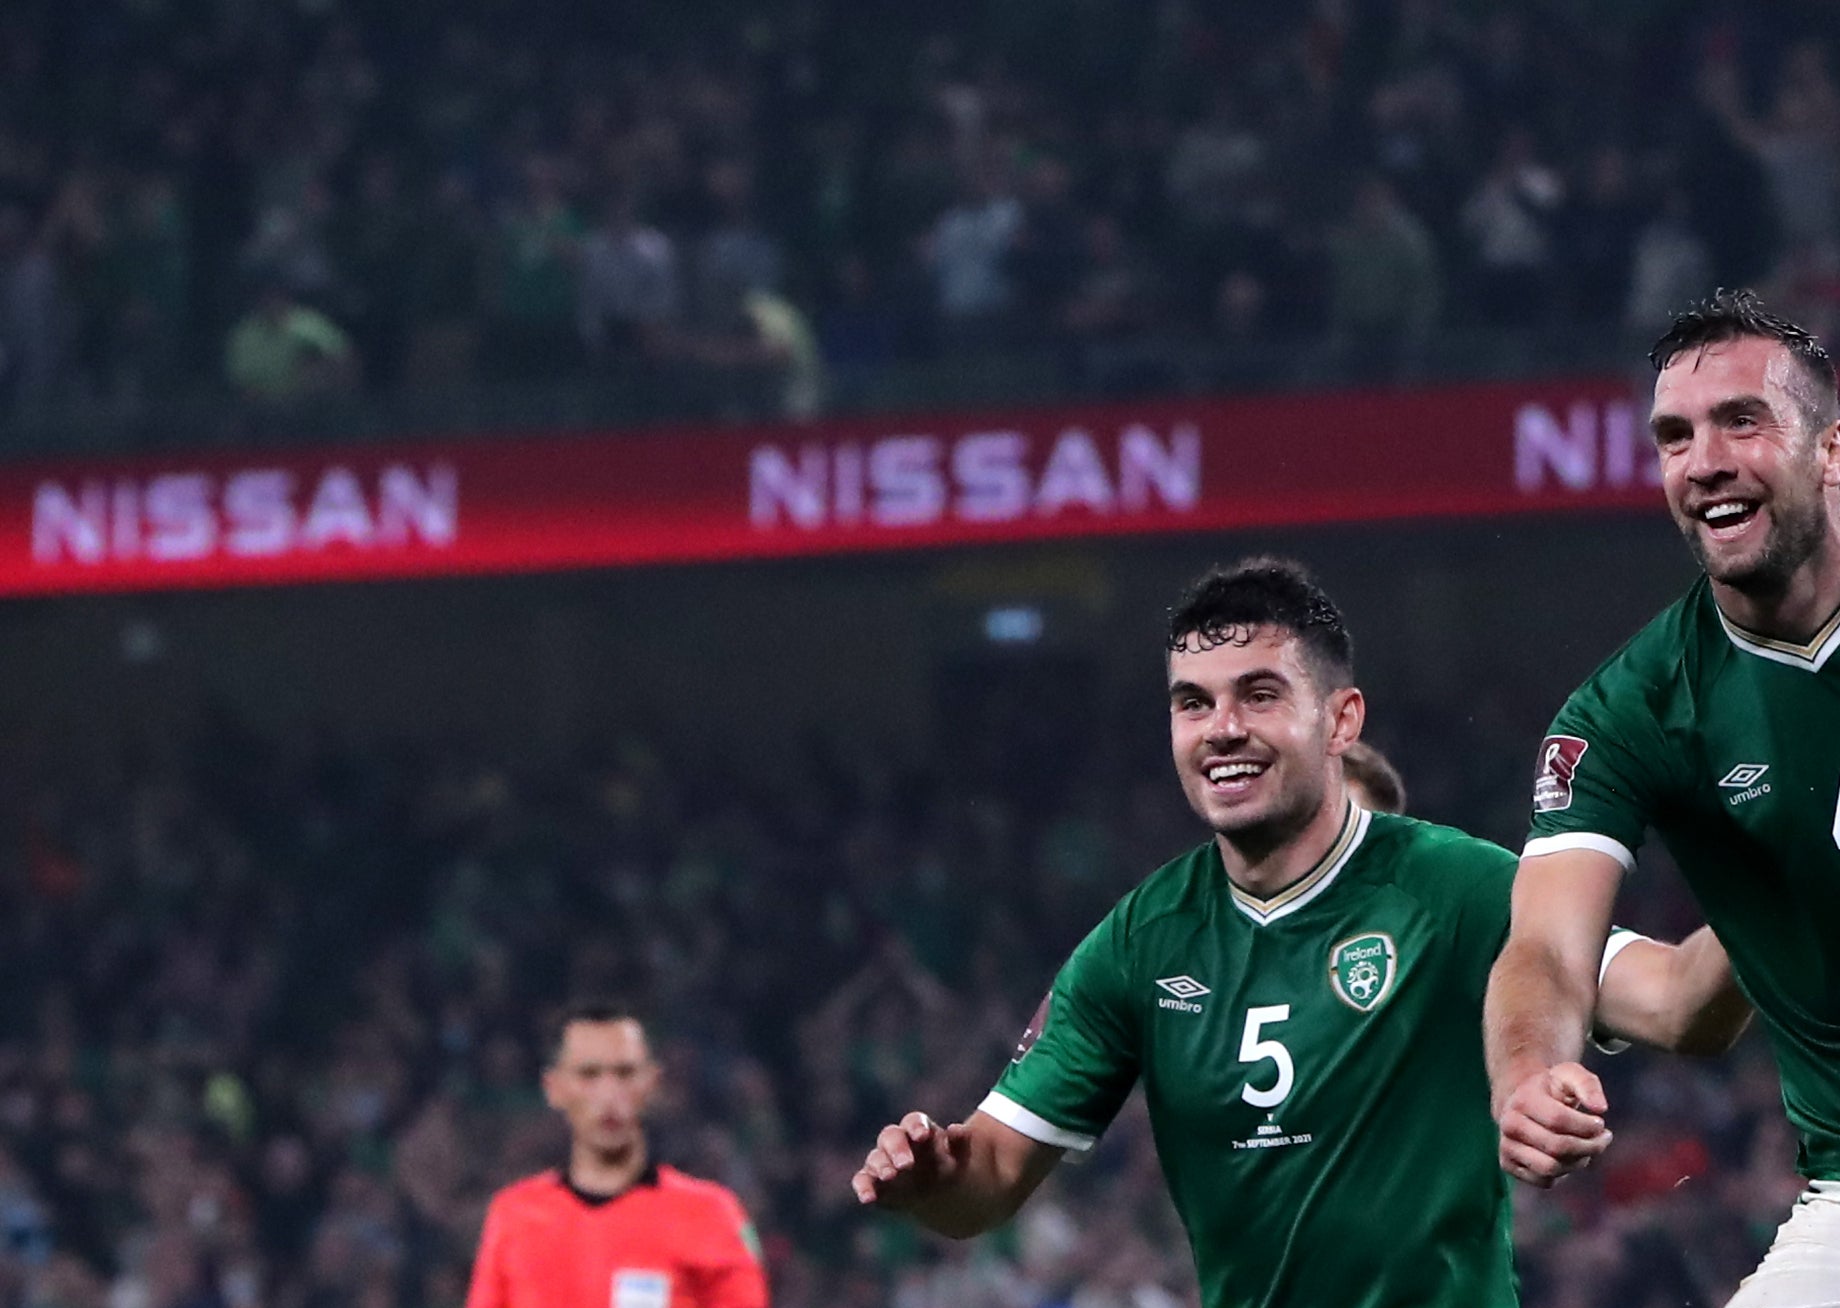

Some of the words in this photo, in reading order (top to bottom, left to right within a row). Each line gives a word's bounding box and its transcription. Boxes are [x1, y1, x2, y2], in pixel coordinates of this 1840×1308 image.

[747, 422, 1202, 532] NISSAN
[30, 463, 459, 566] NISSAN
[1729, 783, 1771, 806] umbro
[1343, 942, 1382, 962] Ireland
[1159, 998, 1202, 1014] umbro
[1238, 1004, 1295, 1108] 5
